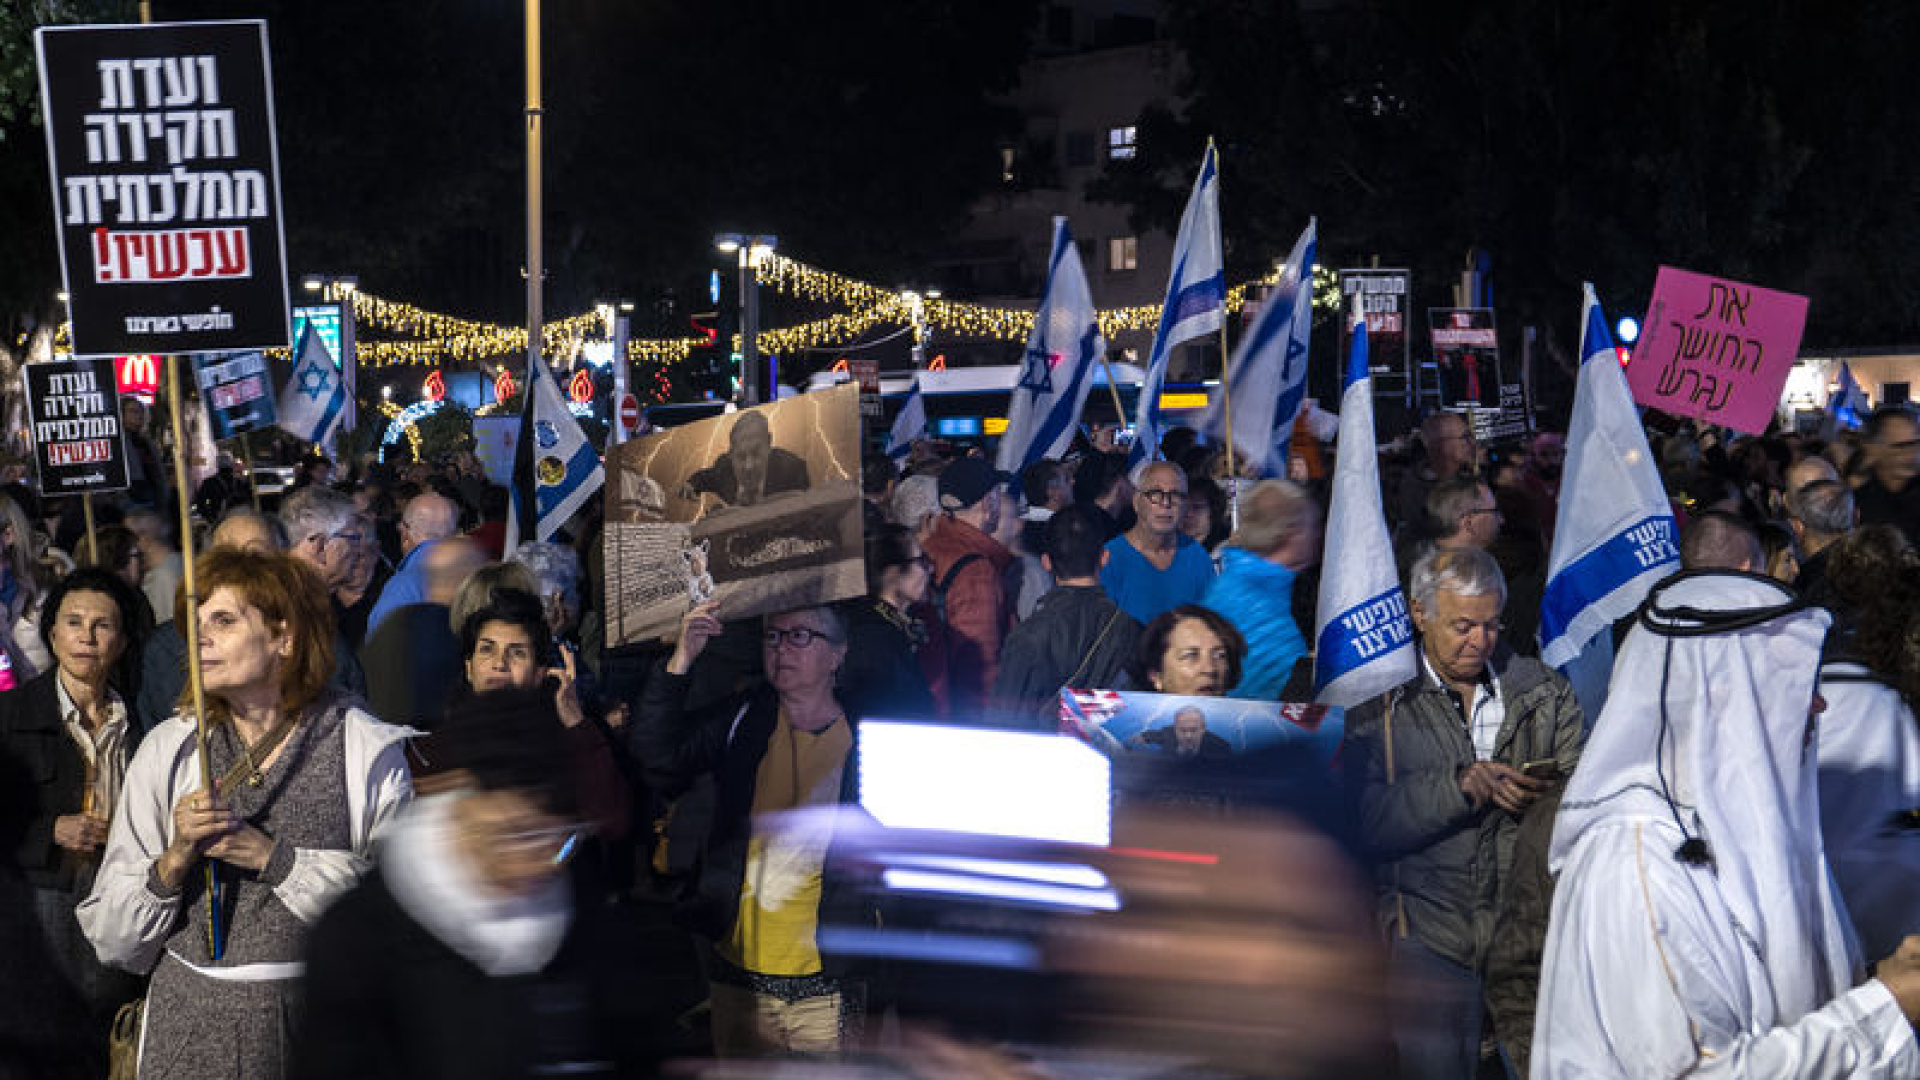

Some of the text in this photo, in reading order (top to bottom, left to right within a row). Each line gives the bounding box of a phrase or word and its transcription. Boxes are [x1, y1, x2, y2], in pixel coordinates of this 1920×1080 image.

[98, 56, 219, 108] ועדת
[84, 109, 238, 163] חקירה
[64, 166, 268, 224] ממלכתית
[96, 227, 247, 280] עכשיו!
[1694, 283, 1752, 327] את
[1670, 321, 1764, 375] החושך
[43, 392, 103, 418] חקירה
[48, 372, 96, 394] ועדת
[1656, 366, 1733, 411] נגרש
[36, 414, 118, 442] ממלכתית
[1351, 615, 1412, 658] ארצנו
